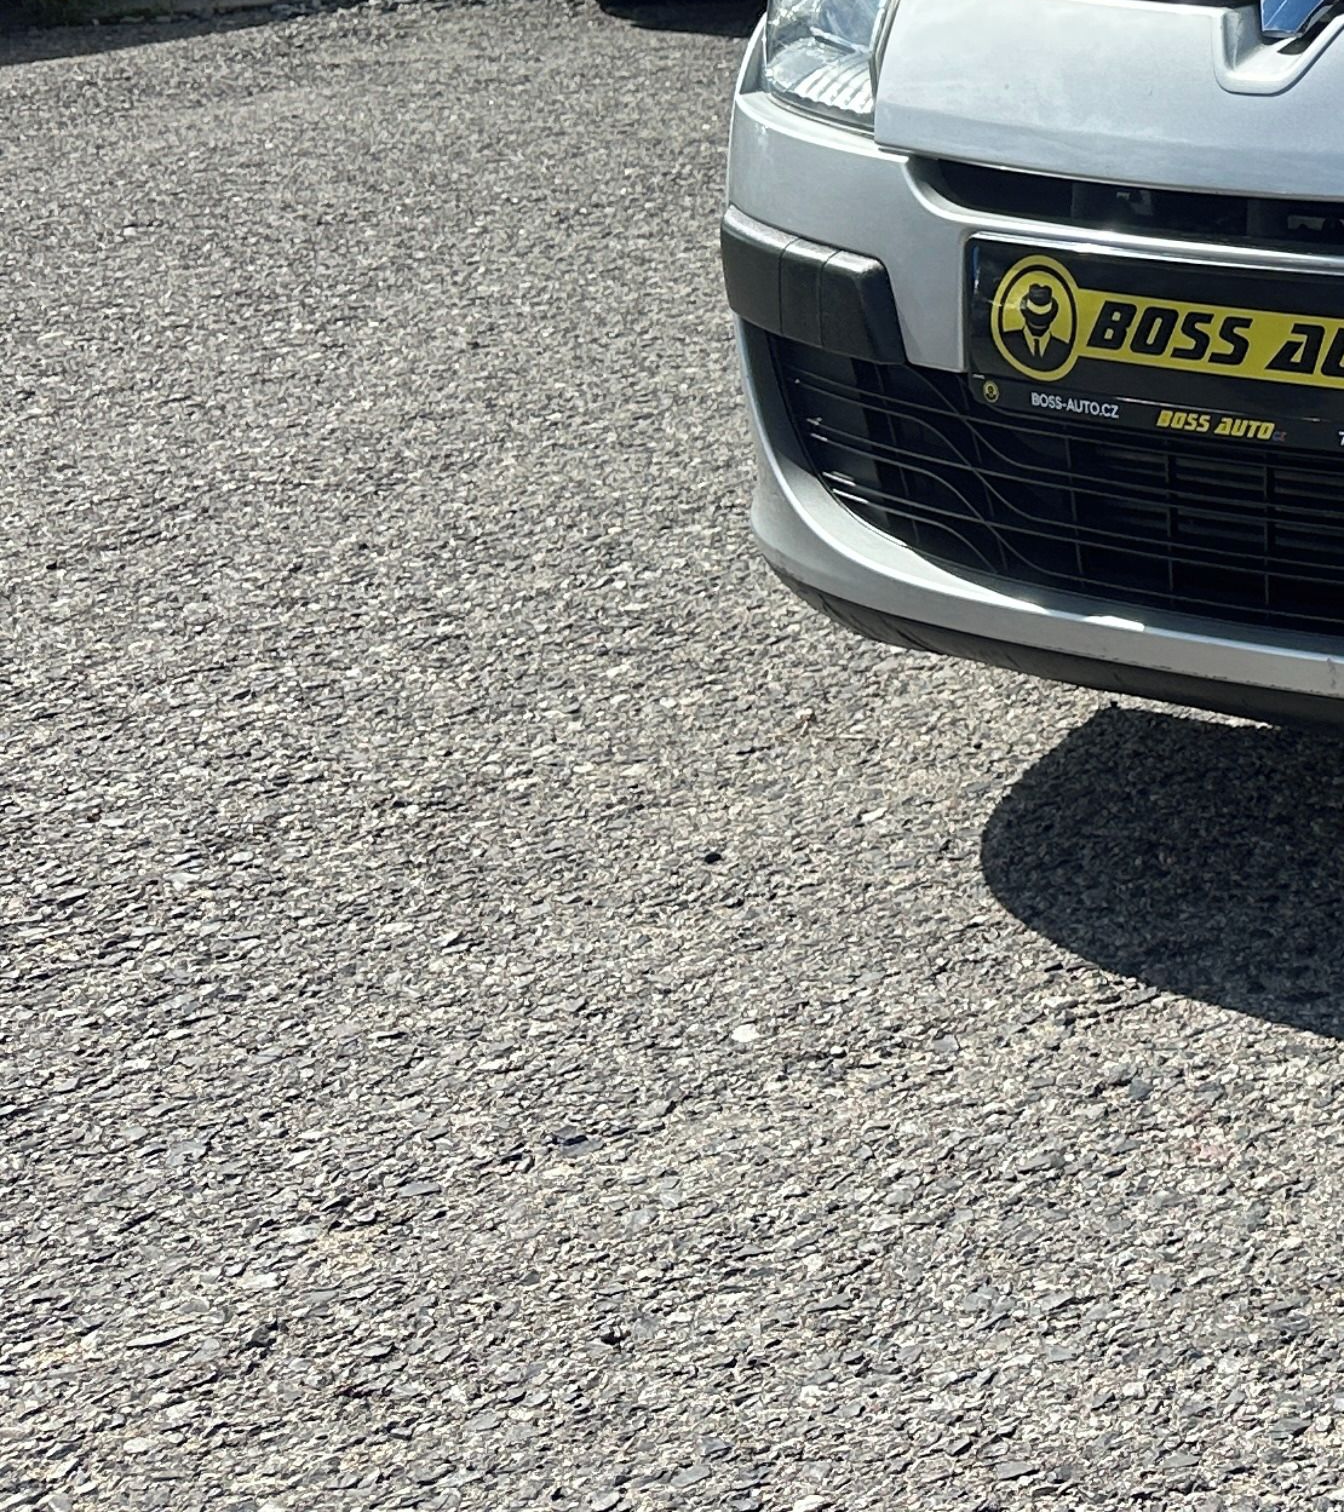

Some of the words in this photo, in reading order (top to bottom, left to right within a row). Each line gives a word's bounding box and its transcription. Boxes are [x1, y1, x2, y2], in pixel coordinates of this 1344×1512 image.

[1086, 300, 1252, 367] BOSS
[1031, 392, 1119, 419] BOSS-AUTO.CZ
[1156, 409, 1211, 432] BOSS
[1214, 417, 1275, 439] AUTO
